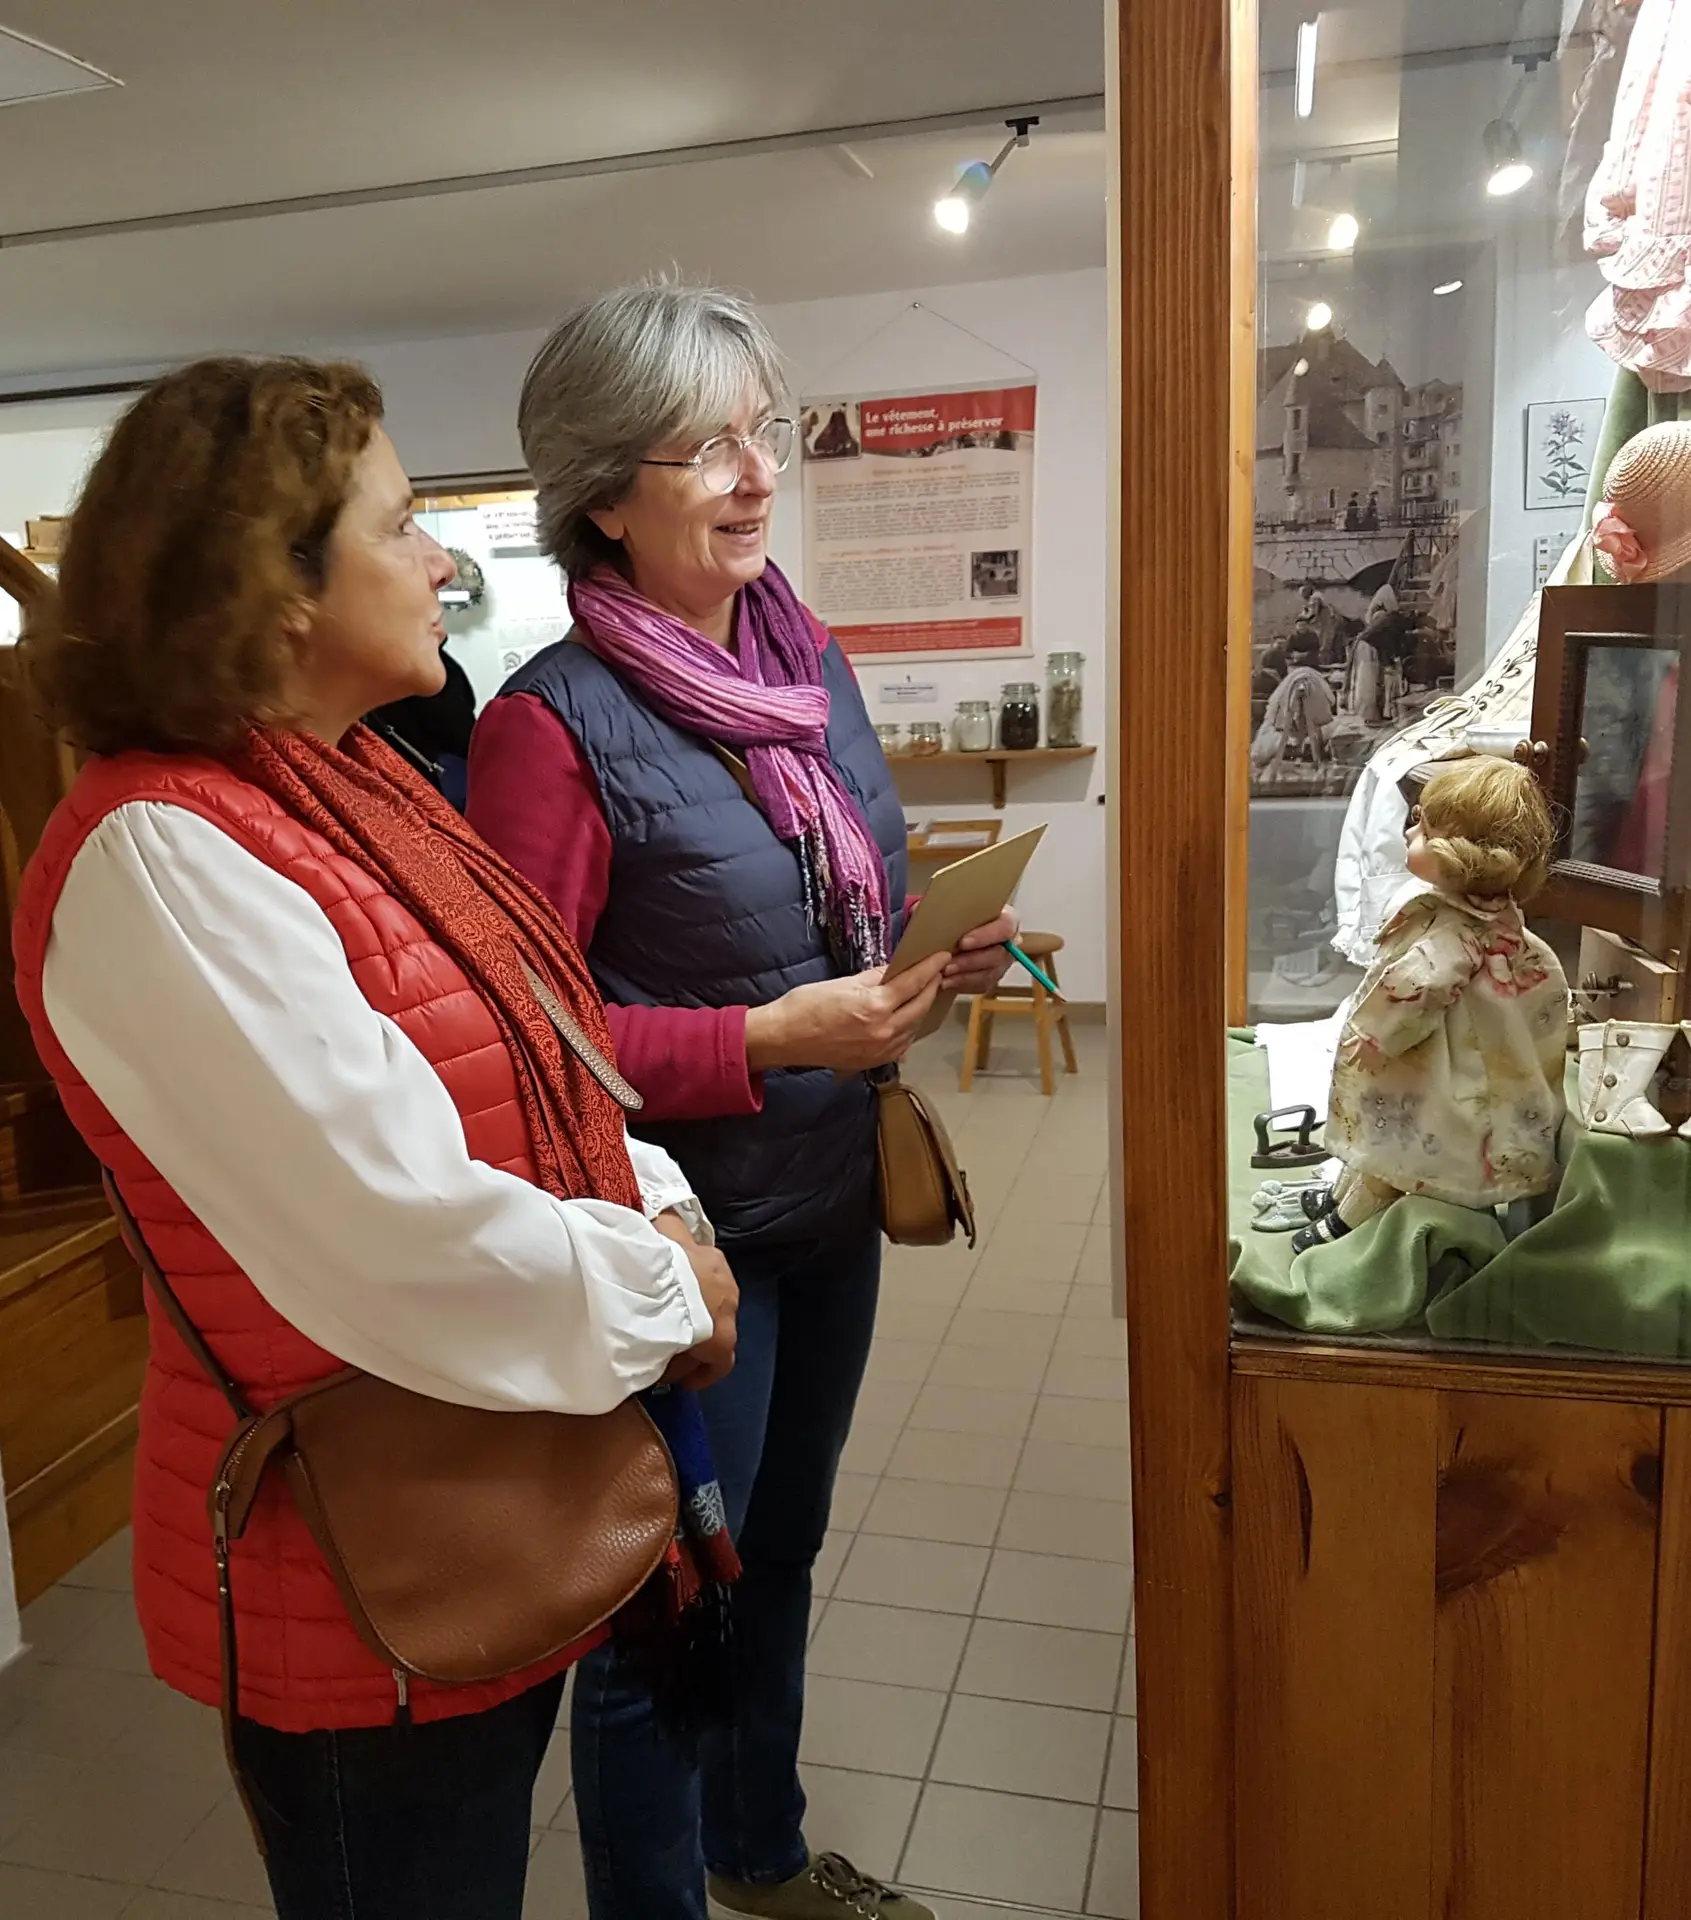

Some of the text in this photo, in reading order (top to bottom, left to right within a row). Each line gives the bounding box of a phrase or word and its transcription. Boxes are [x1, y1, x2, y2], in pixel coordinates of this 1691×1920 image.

[865, 408, 939, 424] Le vêtement,
[865, 416, 1004, 437] une richesse à préserver
